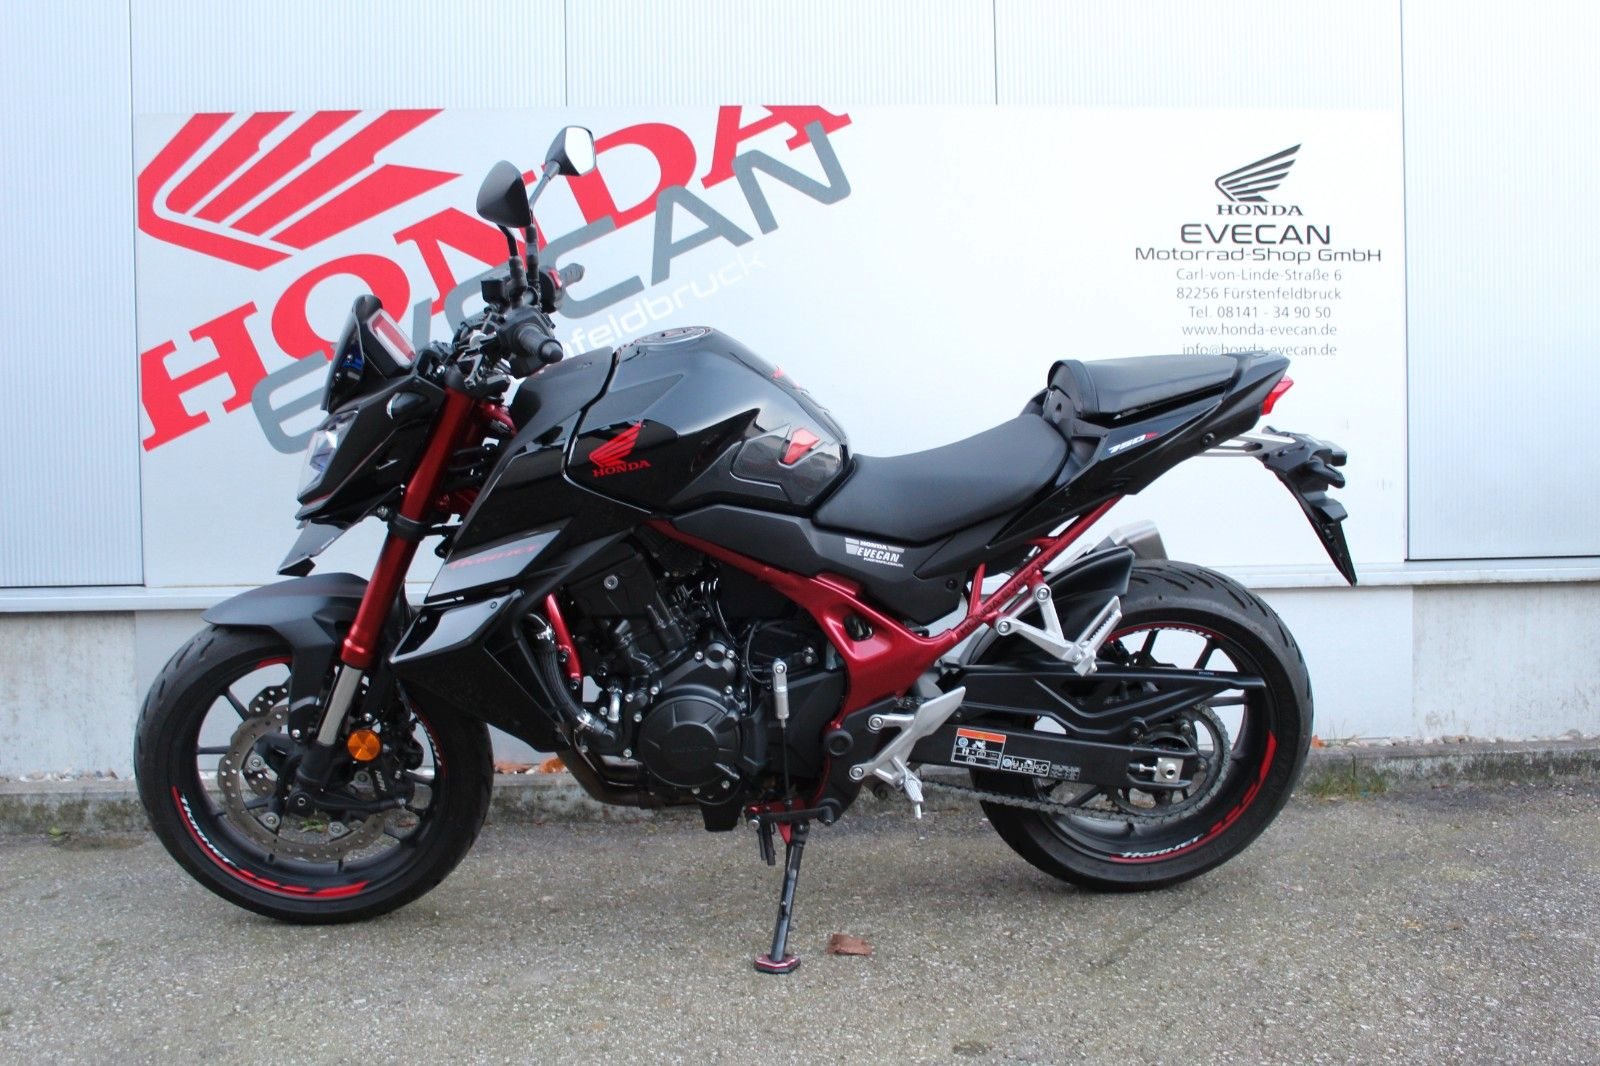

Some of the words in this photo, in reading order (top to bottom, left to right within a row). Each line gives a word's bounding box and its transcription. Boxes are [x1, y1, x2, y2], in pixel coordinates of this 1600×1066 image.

[1216, 204, 1304, 216] HONDA
[1180, 223, 1330, 245] EVECAN
[1135, 247, 1311, 265] Motorrad-Shop
[1317, 248, 1382, 262] GmbH
[1176, 267, 1330, 281] Carl-von-Linde-Straße
[1333, 269, 1342, 281] 6
[1176, 287, 1219, 299] 82256
[1223, 286, 1342, 300] Fürstenfeldbruck
[1188, 305, 1212, 318] Tel.
[1216, 305, 1258, 318] 08141
[1273, 306, 1289, 318] 34
[1293, 306, 1310, 318] 90
[1315, 306, 1331, 318] 50
[1181, 323, 1337, 336] www.honda-evecan.de
[592, 459, 652, 478] HONDA
[856, 547, 900, 563] EVECAN
